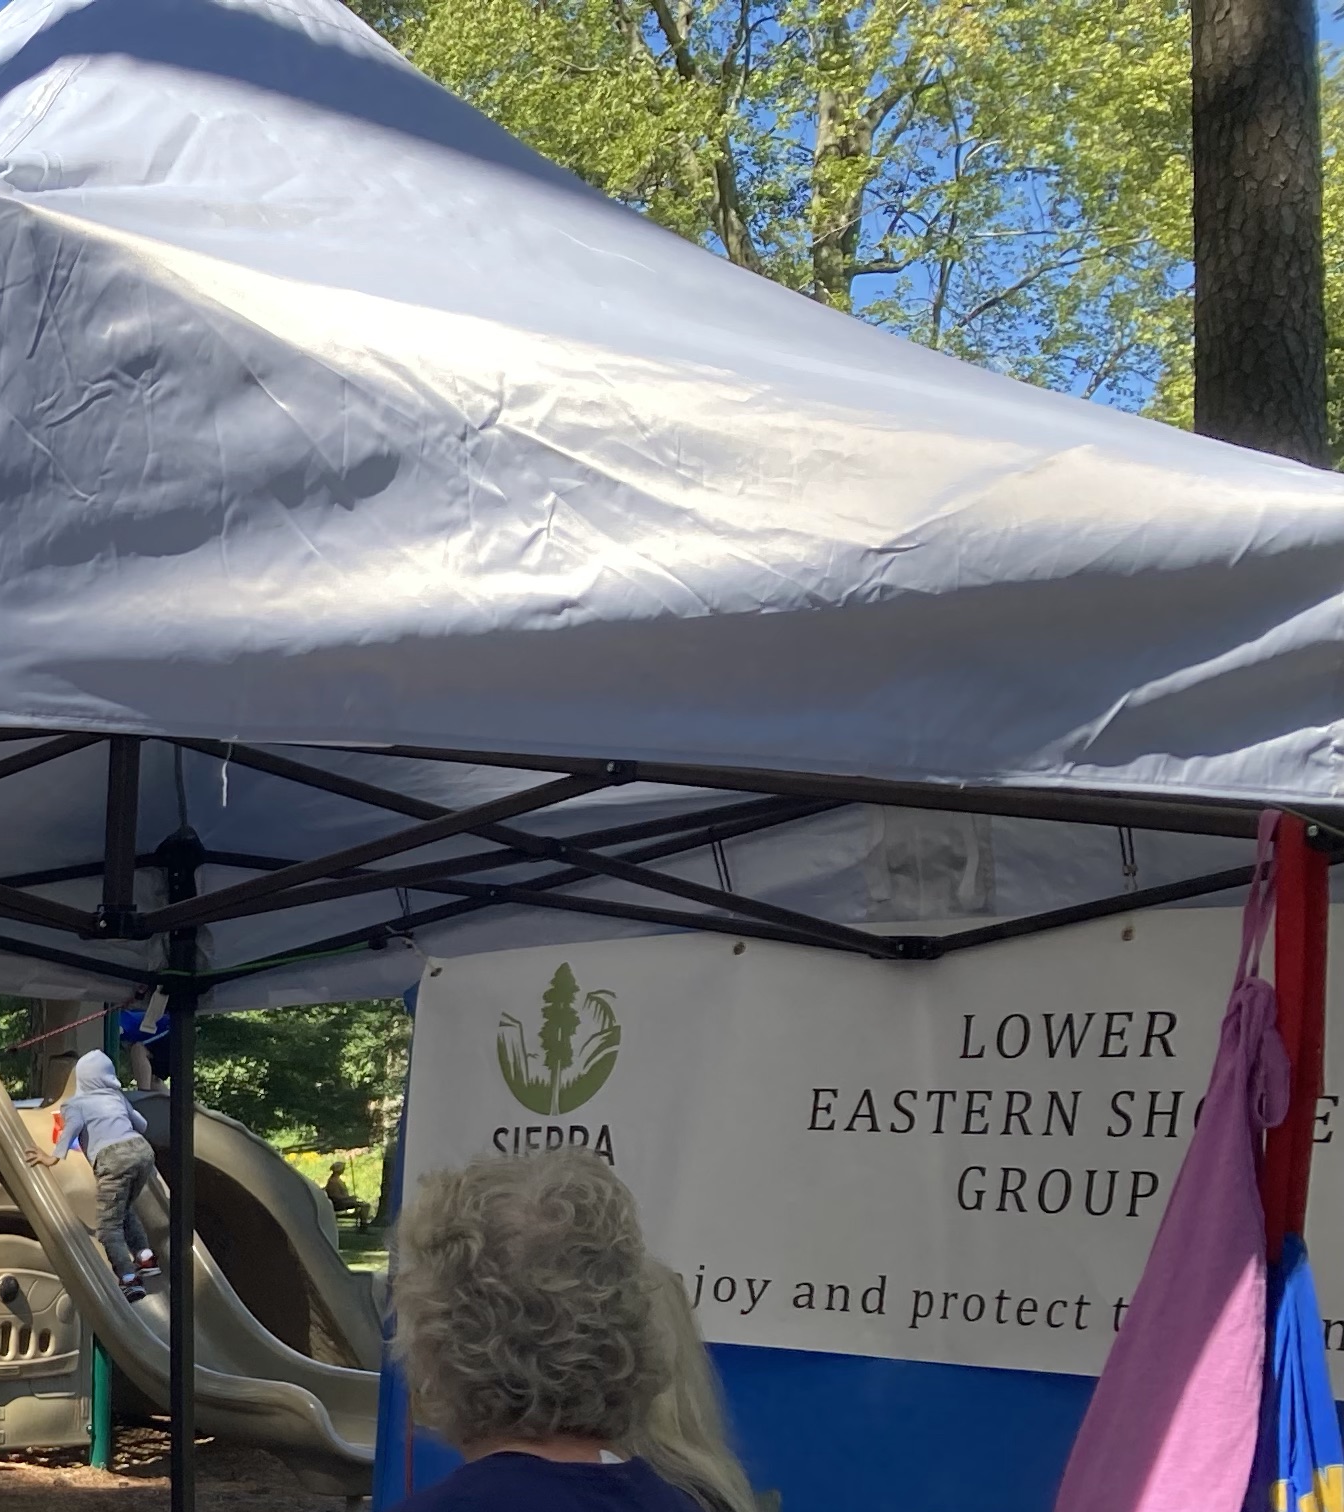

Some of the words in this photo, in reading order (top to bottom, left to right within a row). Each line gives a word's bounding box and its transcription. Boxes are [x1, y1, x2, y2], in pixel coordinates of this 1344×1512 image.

[960, 1010, 1179, 1061] LOWER
[808, 1086, 1082, 1138] EASTERN
[1107, 1091, 1340, 1144] SHE
[957, 1165, 1161, 1219] GROUP
[673, 1264, 773, 1316] joy
[790, 1275, 887, 1317] and
[909, 1282, 1092, 1331] protect
